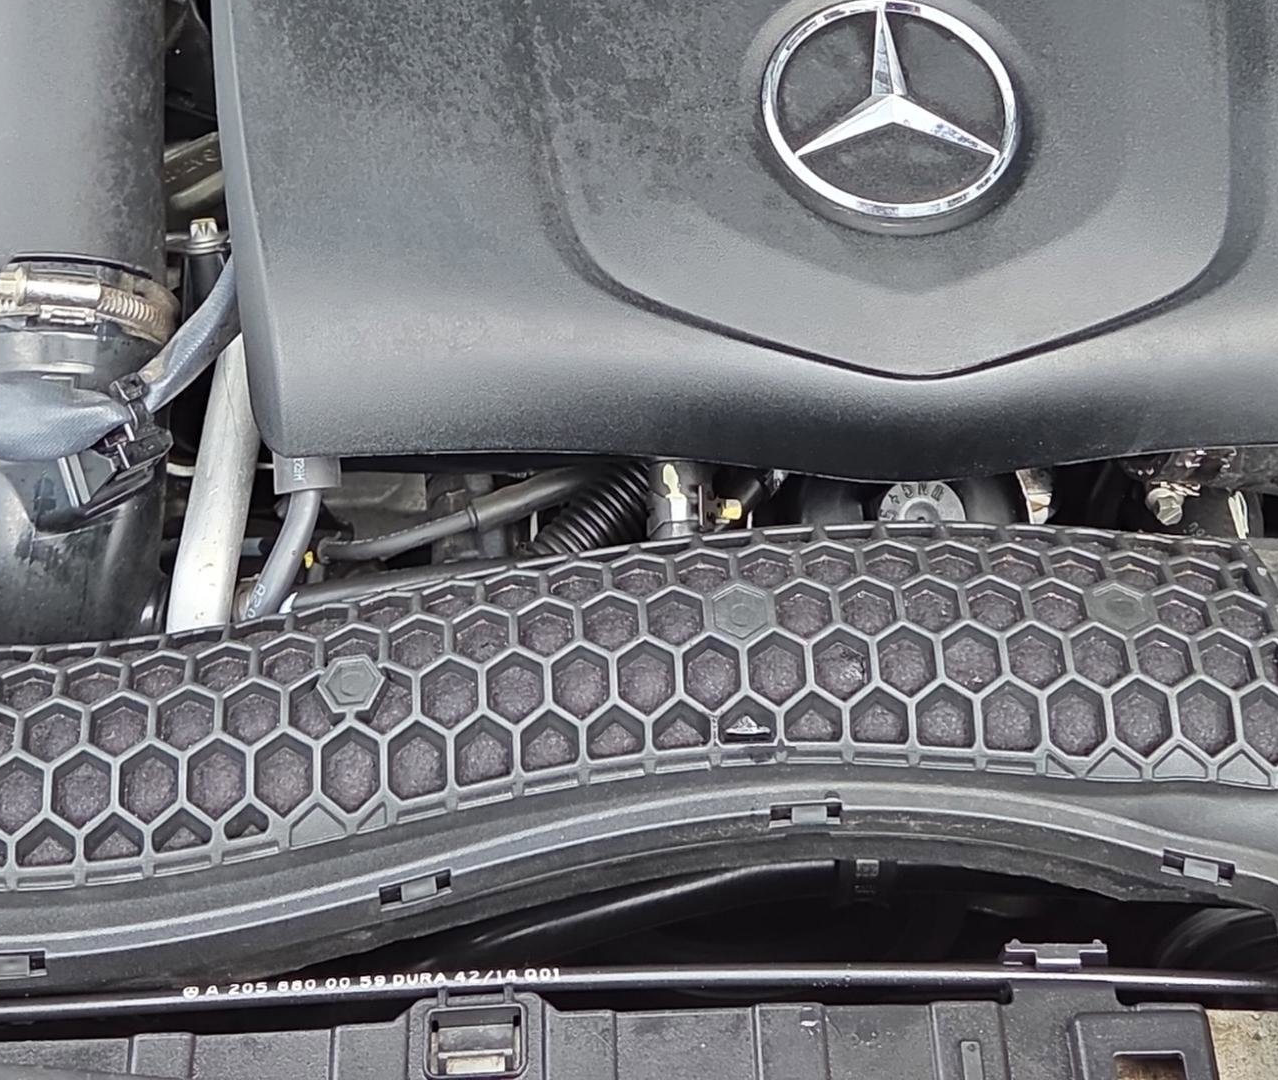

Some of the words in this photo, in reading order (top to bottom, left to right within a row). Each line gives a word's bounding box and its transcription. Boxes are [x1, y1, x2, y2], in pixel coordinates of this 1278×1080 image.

[205, 984, 219, 997] A
[228, 981, 268, 996] 205
[324, 976, 351, 990] 00
[359, 974, 385, 989] 59
[393, 971, 447, 987] DURA
[454, 968, 517, 985] 42/14
